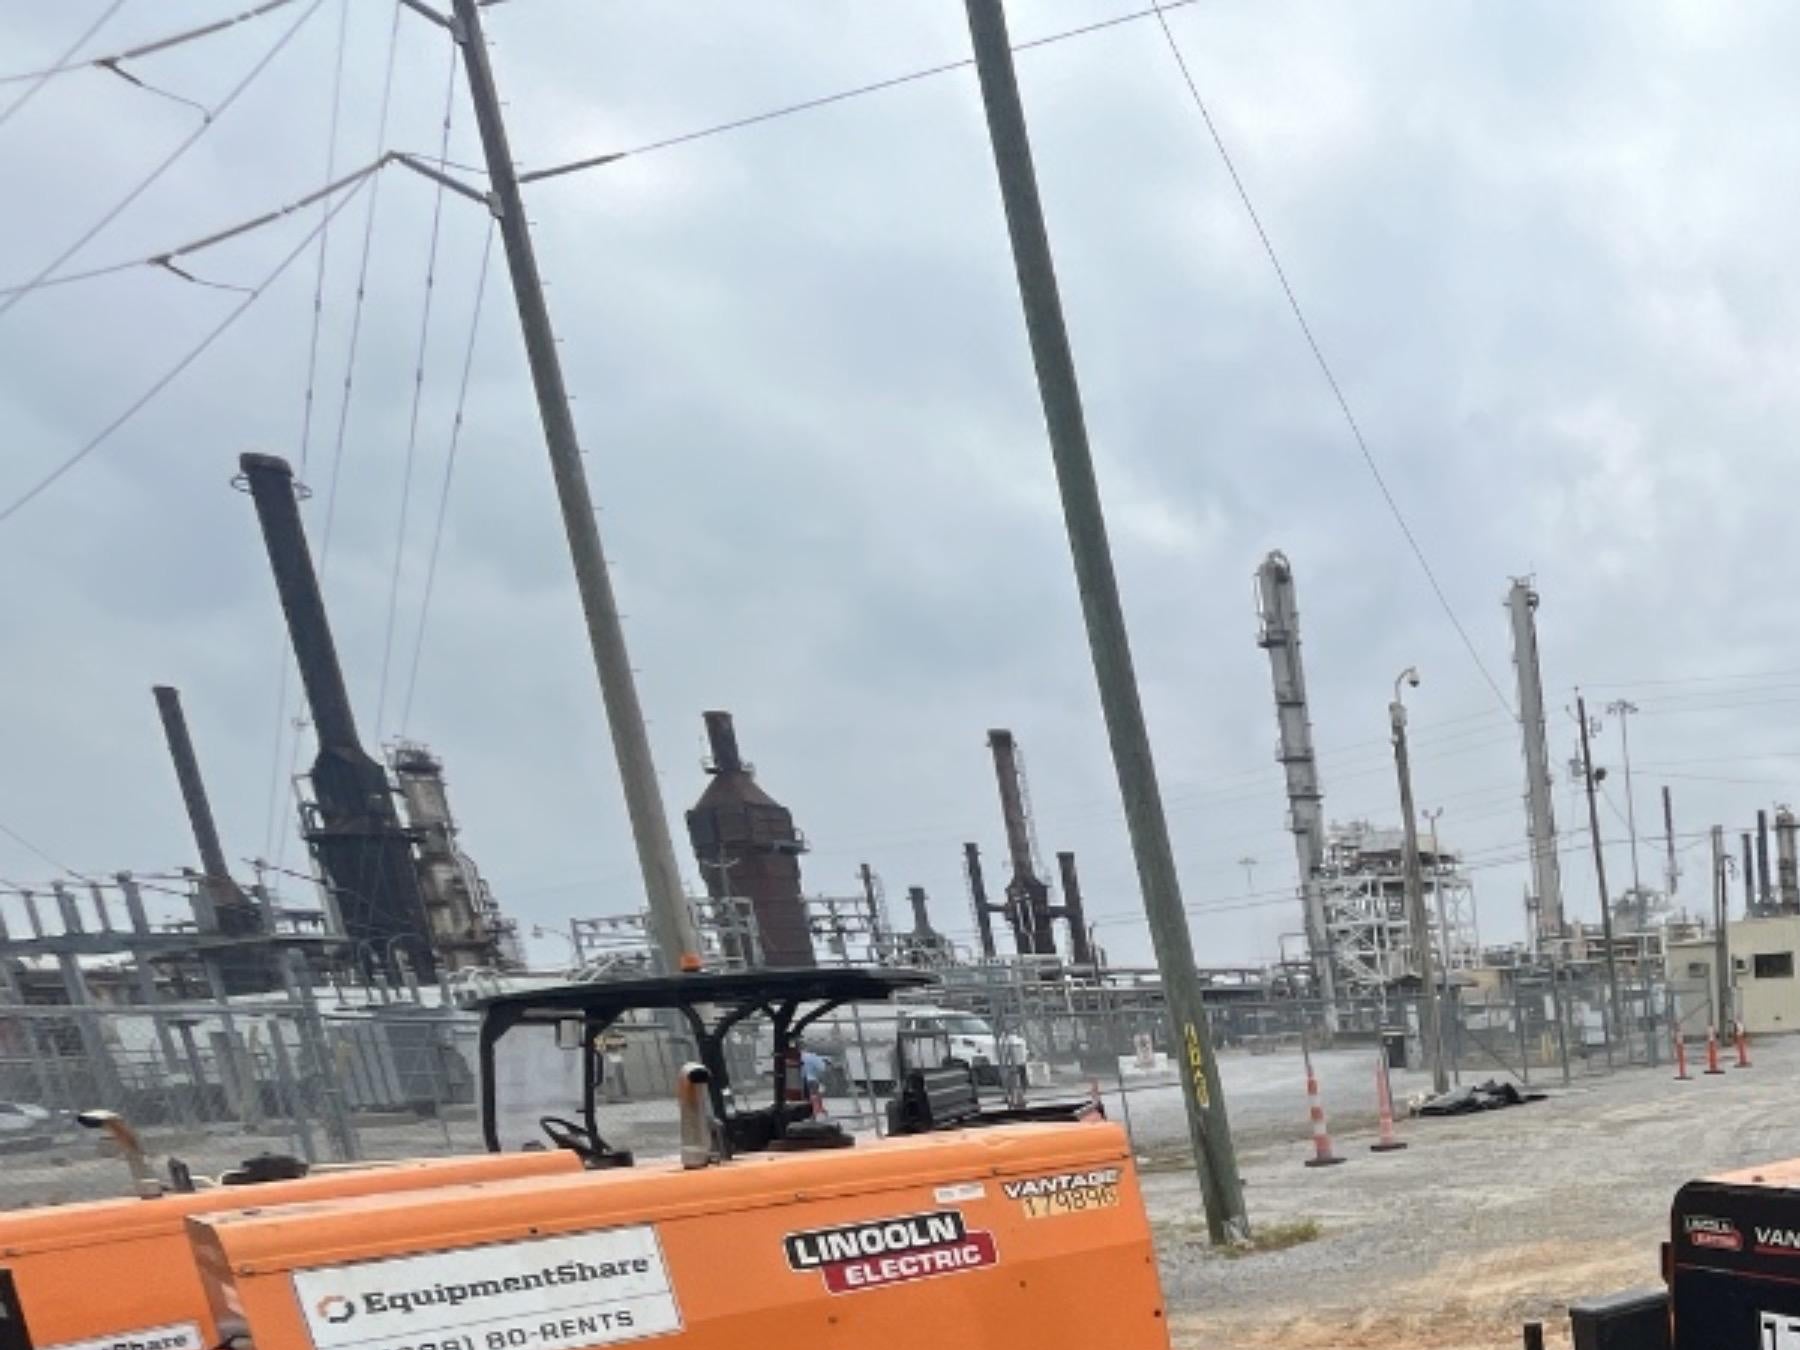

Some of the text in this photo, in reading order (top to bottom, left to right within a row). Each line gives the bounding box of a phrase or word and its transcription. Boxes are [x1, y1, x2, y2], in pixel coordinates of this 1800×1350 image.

[794, 1215, 958, 1265] LINCOLN
[361, 1257, 648, 1314] EquipmentShare
[844, 1245, 981, 1286] ELECTRIC
